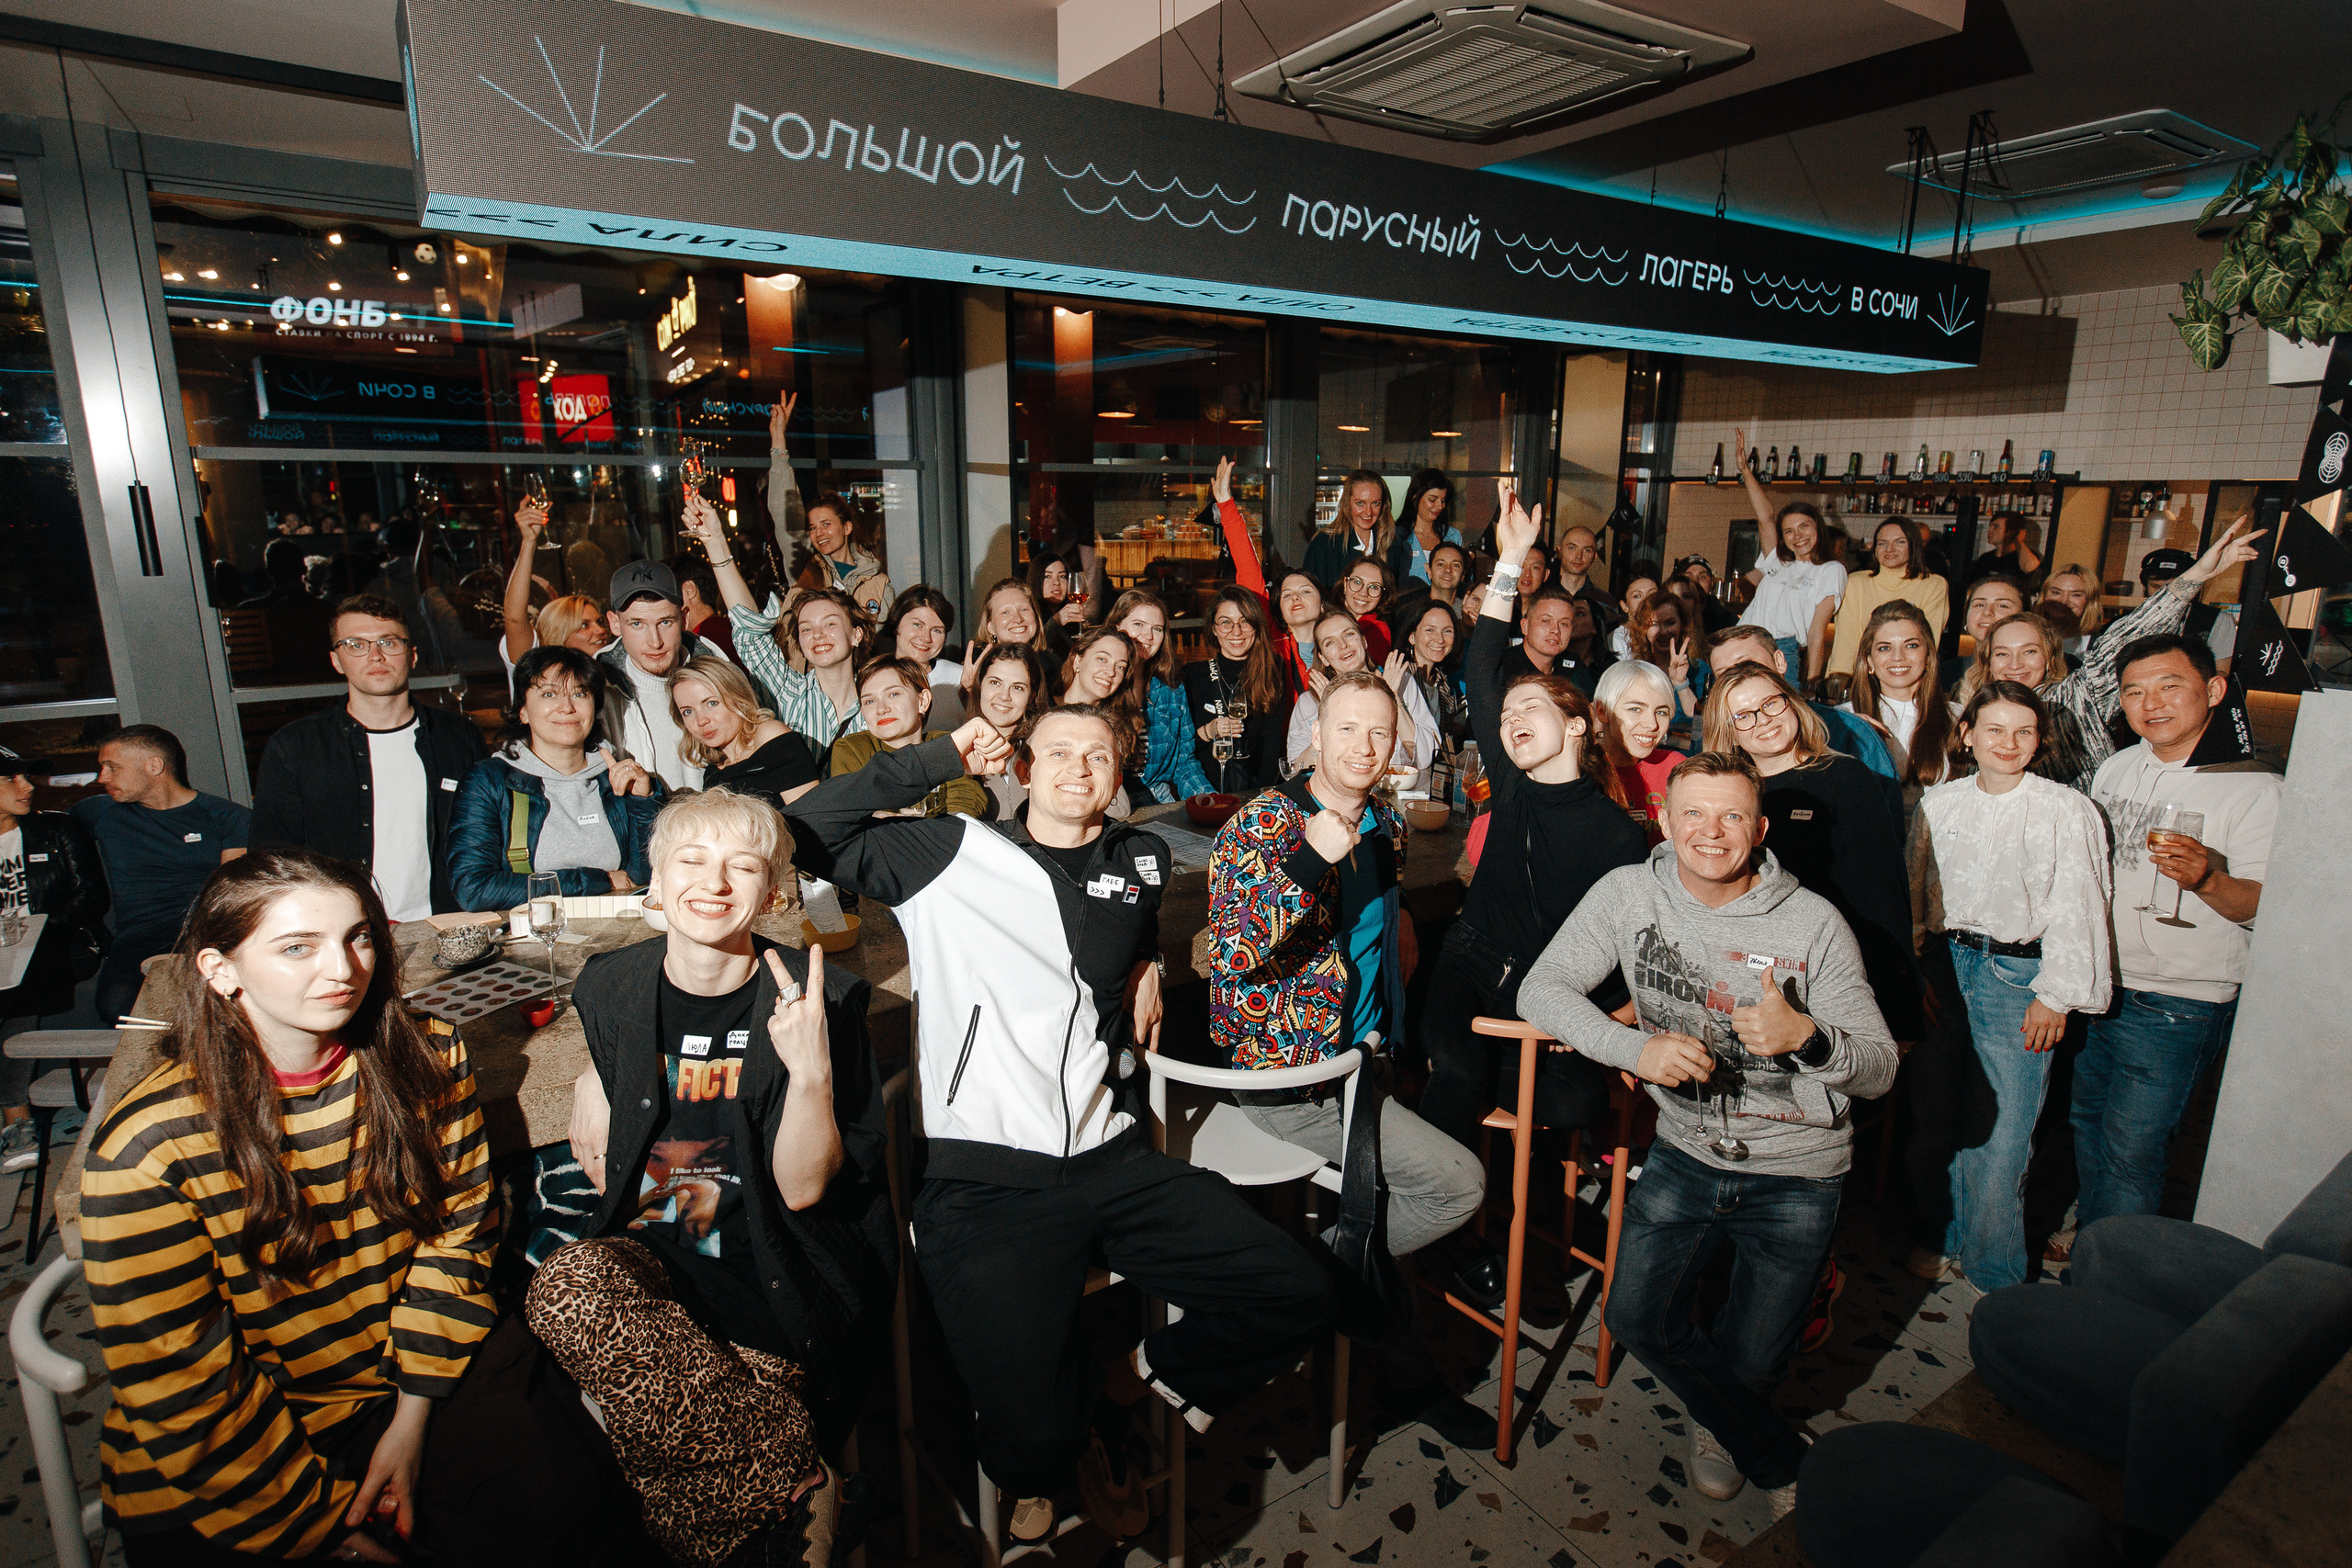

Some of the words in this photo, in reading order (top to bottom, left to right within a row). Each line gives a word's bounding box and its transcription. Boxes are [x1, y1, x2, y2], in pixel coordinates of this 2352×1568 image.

[729, 103, 1025, 195] БОЛЬШОЙ
[1282, 193, 1481, 261] ПАРУСНЫЙ
[1639, 253, 1734, 294] ЛАГЕРЬ
[1850, 286, 1864, 312] В
[1869, 288, 1919, 320] СОЧИ
[588, 221, 789, 253] СИЛА
[345, 331, 384, 340] СПОРТ
[676, 1057, 743, 1102] FICT
[703, 1166, 722, 1174] look
